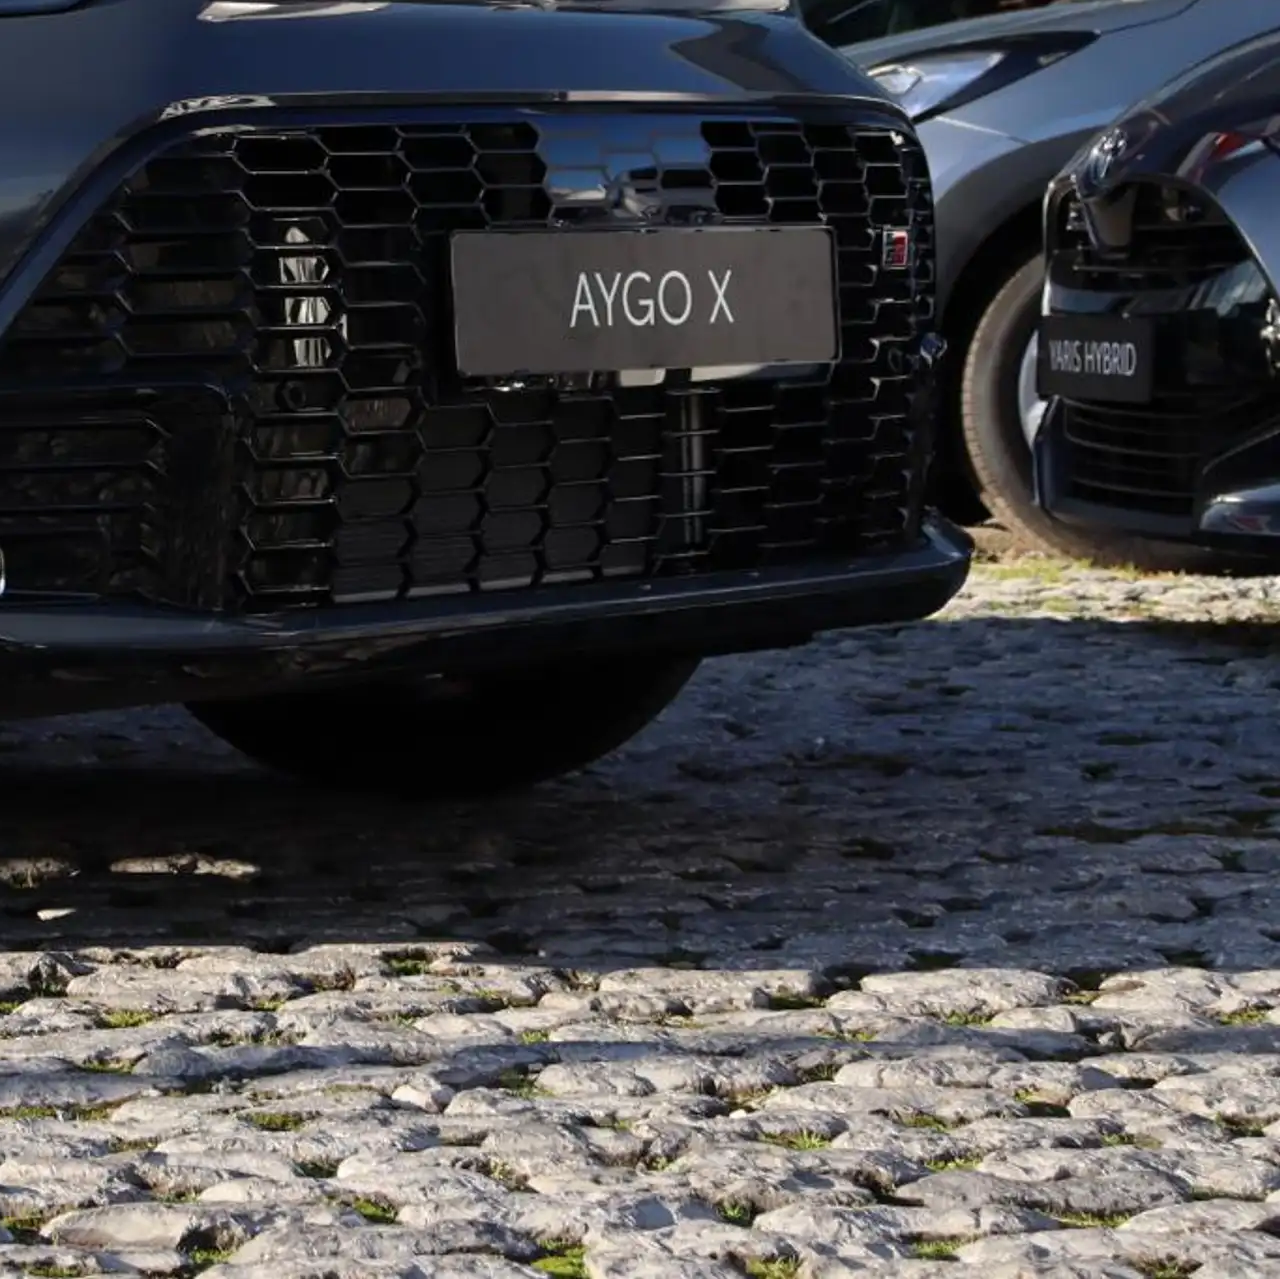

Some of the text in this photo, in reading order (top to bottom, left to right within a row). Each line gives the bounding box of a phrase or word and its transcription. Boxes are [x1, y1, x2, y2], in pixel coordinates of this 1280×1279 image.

[570, 269, 734, 328] AYGO X
[1084, 341, 1137, 377] HYBRID
